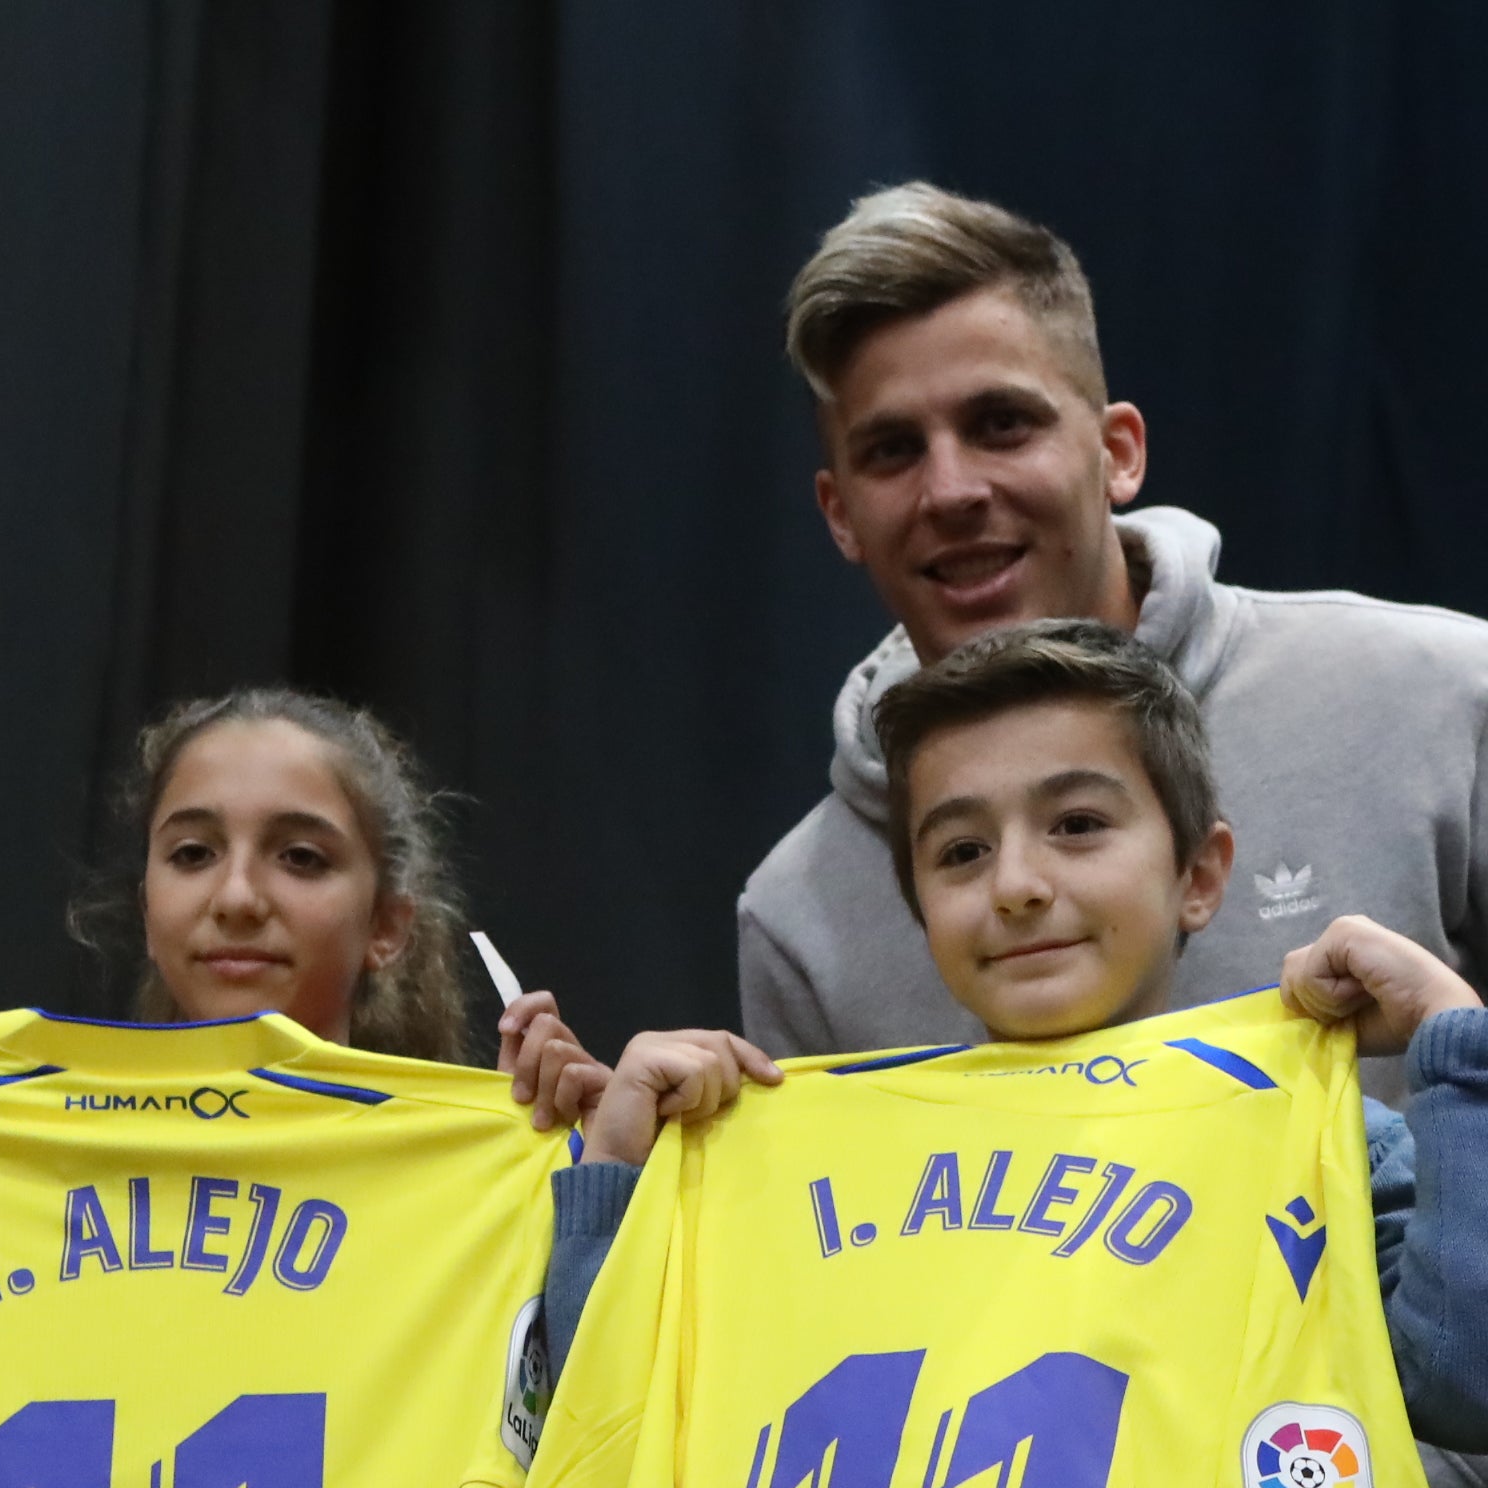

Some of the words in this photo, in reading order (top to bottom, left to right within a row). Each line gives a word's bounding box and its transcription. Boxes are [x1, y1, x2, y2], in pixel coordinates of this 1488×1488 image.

[1259, 897, 1321, 919] adidas
[59, 1176, 350, 1297] ALEJO
[809, 1177, 878, 1259] I.
[900, 1150, 1194, 1266] ALEJO
